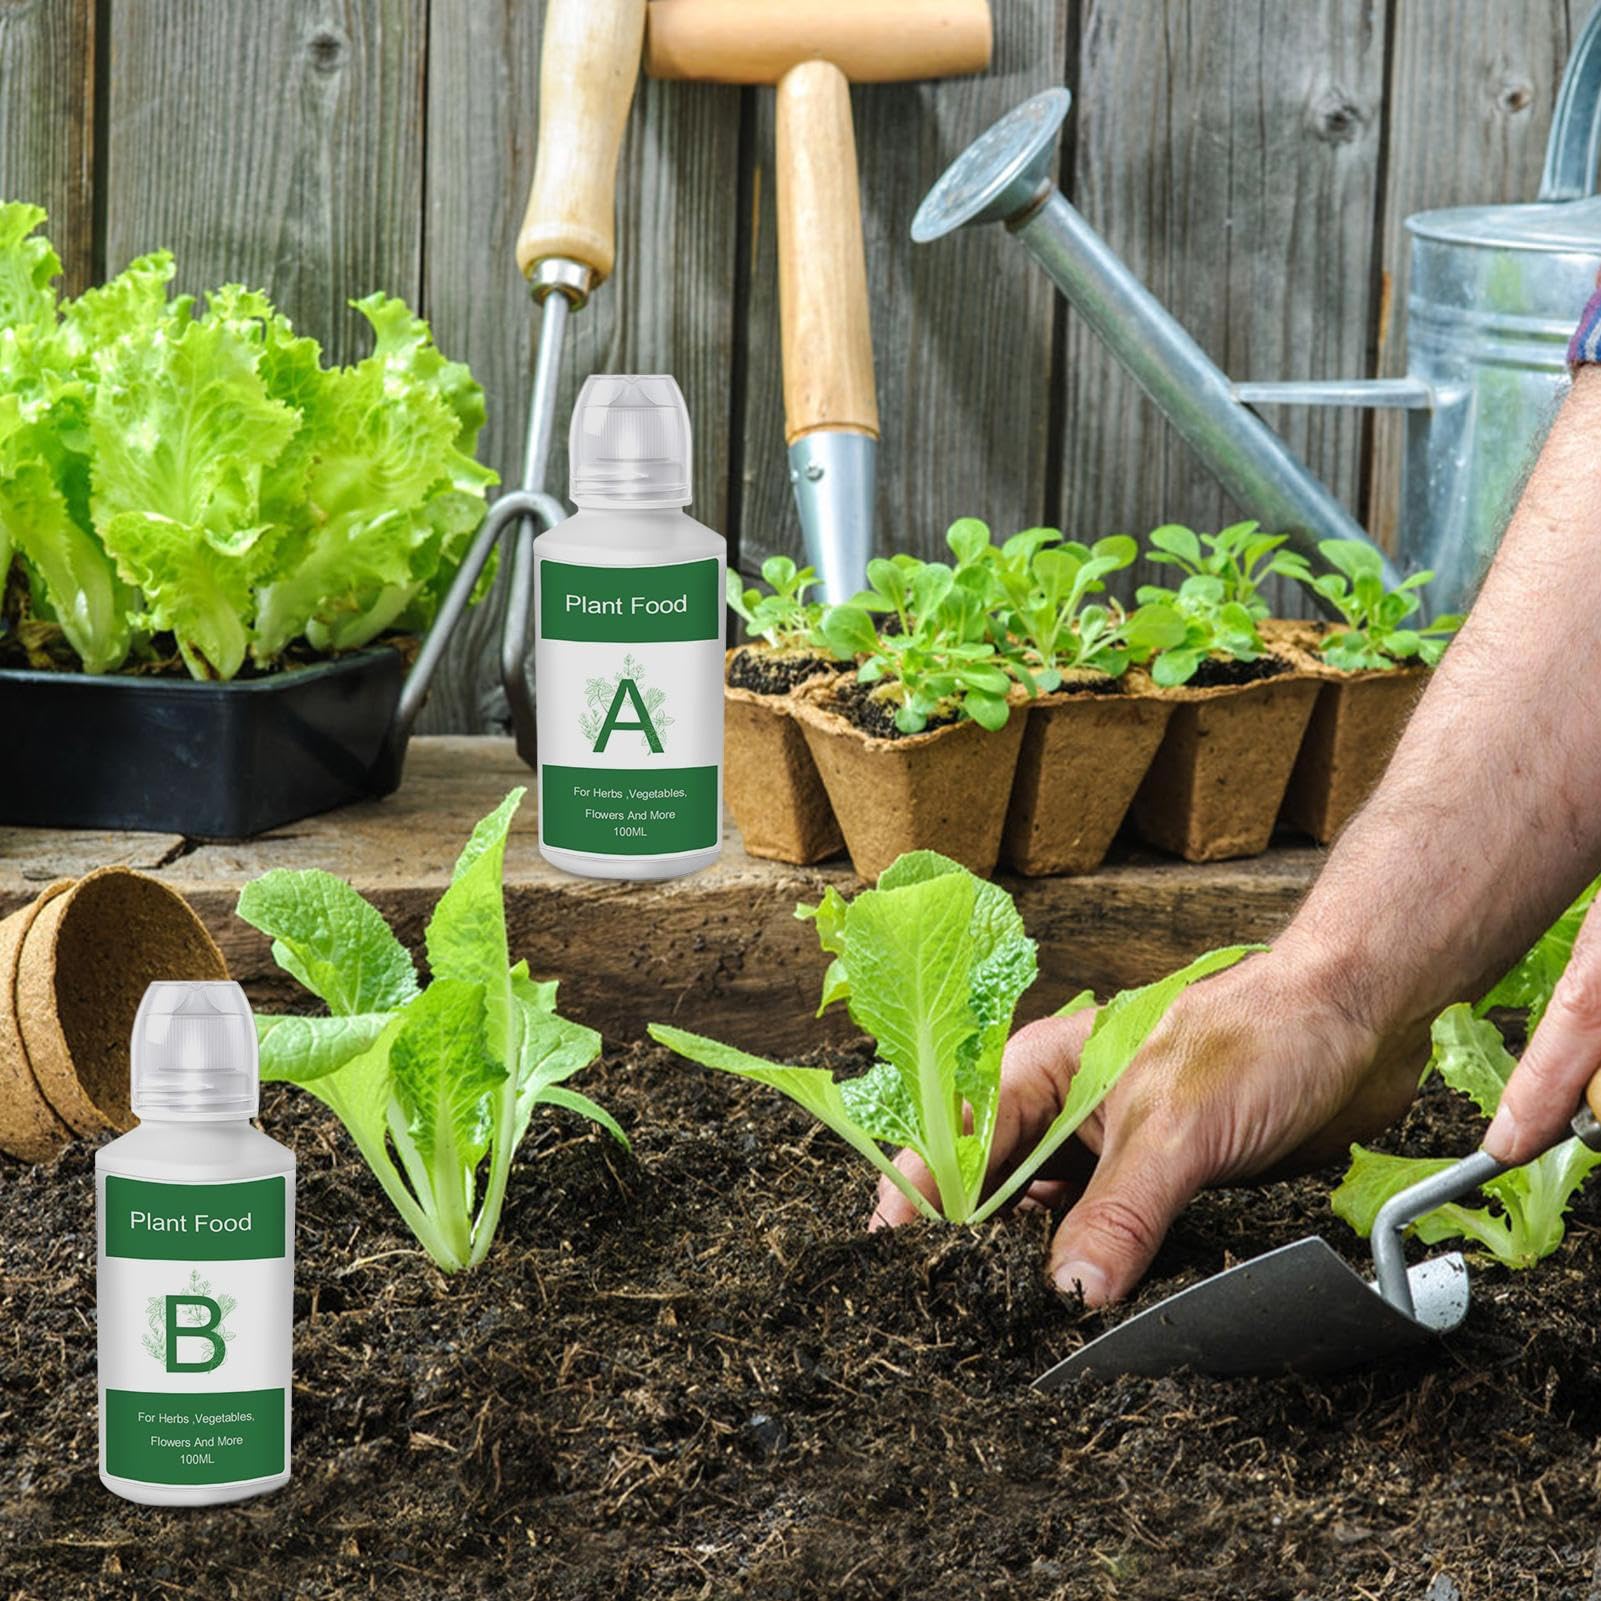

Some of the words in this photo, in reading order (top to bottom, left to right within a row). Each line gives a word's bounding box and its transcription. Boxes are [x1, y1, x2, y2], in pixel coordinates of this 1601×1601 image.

[566, 593, 624, 616] Plant
[632, 593, 688, 615] Food
[592, 679, 665, 754] A
[573, 786, 591, 797] For
[593, 787, 623, 799] Herbs
[585, 808, 625, 820] Flowers
[627, 810, 647, 820] And
[650, 810, 676, 820] More
[614, 826, 648, 837] 100ML
[130, 1210, 188, 1233] Plant
[195, 1212, 252, 1233] Food
[165, 1295, 226, 1373] B
[138, 1411, 156, 1423] For
[159, 1413, 190, 1424] Herbs
[150, 1435, 191, 1448] Flowers
[194, 1437, 215, 1447] And
[218, 1436, 244, 1447] More
[180, 1454, 215, 1465] 100ML
